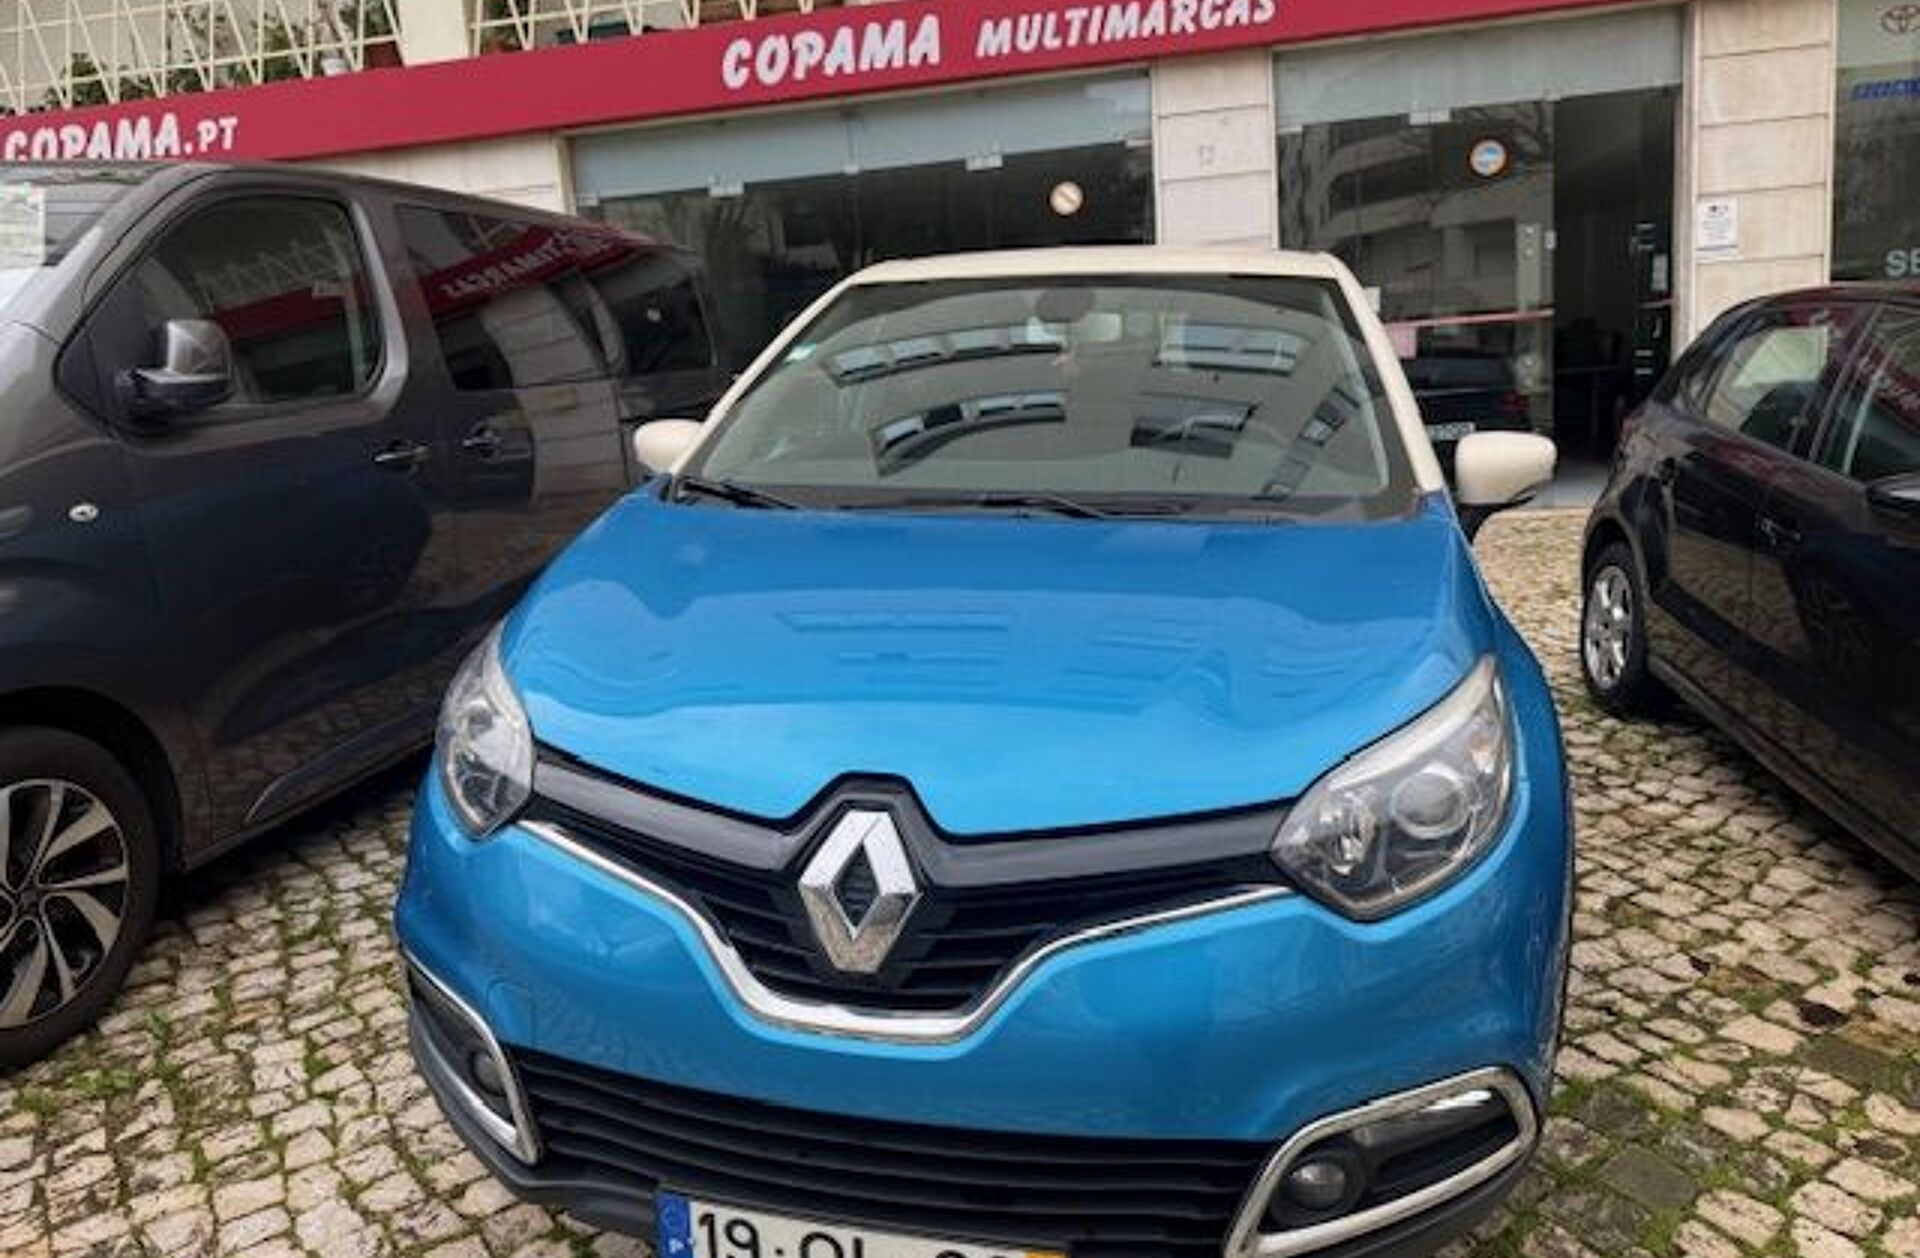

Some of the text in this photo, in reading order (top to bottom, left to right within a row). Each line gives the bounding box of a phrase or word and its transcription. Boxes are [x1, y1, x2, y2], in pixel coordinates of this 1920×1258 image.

[722, 0, 1277, 90] COPAMA MULTIMARCAS
[5, 112, 239, 162] COPAMA.PT
